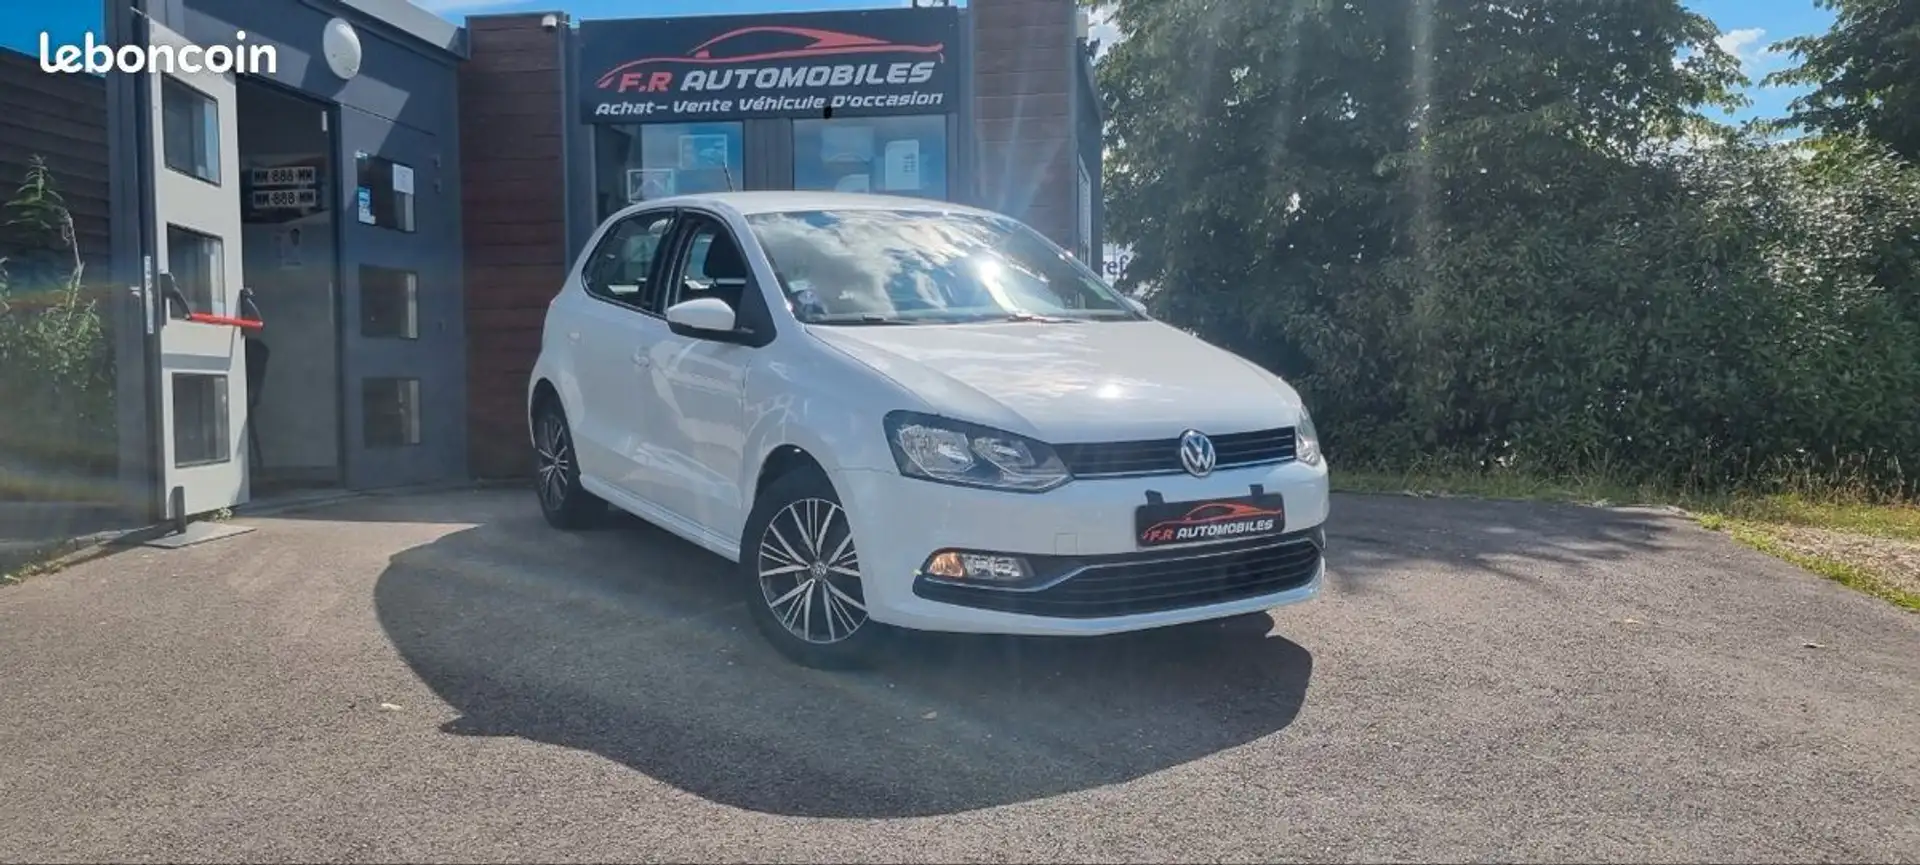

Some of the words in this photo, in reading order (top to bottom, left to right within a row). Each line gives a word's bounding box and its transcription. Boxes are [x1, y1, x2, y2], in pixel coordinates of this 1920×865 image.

[618, 72, 673, 93] F.R
[680, 61, 936, 91] AUTOMOBILES
[674, 99, 733, 113] Vente
[739, 95, 826, 112] Véhicule
[831, 90, 944, 109] D'occasion
[1176, 519, 1274, 540] AUTOMOBILES
